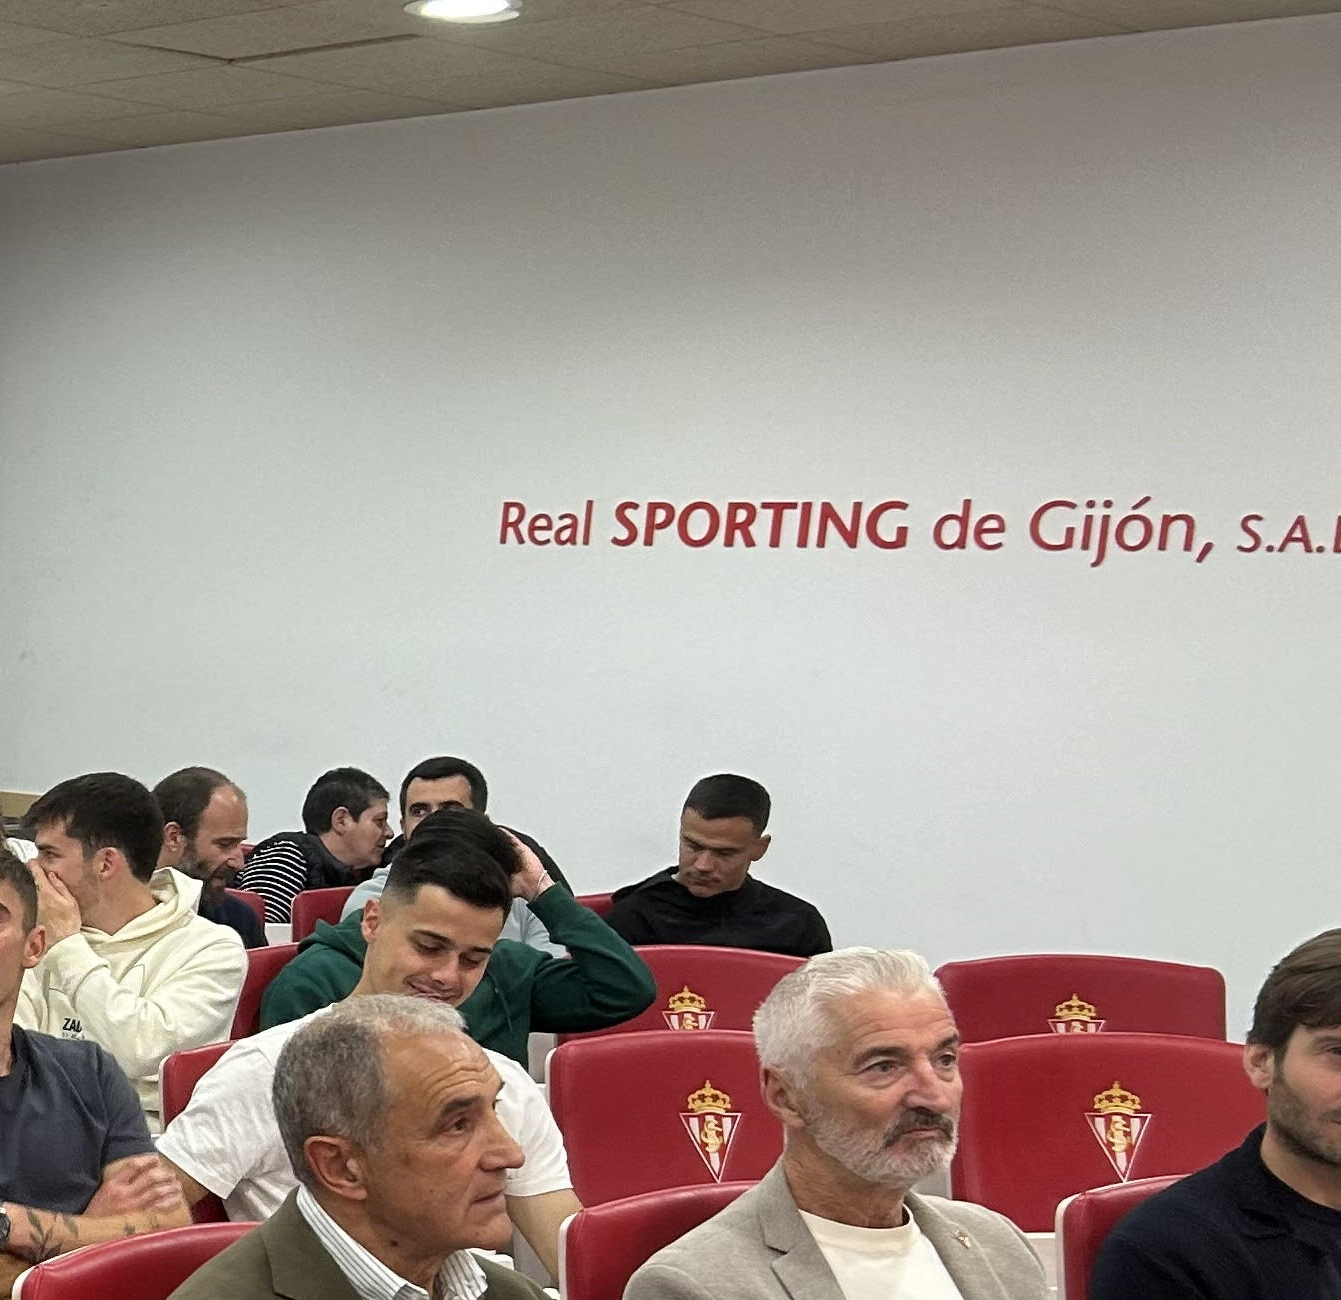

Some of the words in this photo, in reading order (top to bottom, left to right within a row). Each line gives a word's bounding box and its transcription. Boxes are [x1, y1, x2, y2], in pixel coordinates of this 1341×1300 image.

[500, 499, 594, 546] Real
[610, 500, 910, 550] SPORTING
[933, 499, 1007, 551] de
[1030, 495, 1215, 569] Gijón,
[1236, 513, 1341, 554] S.A.
